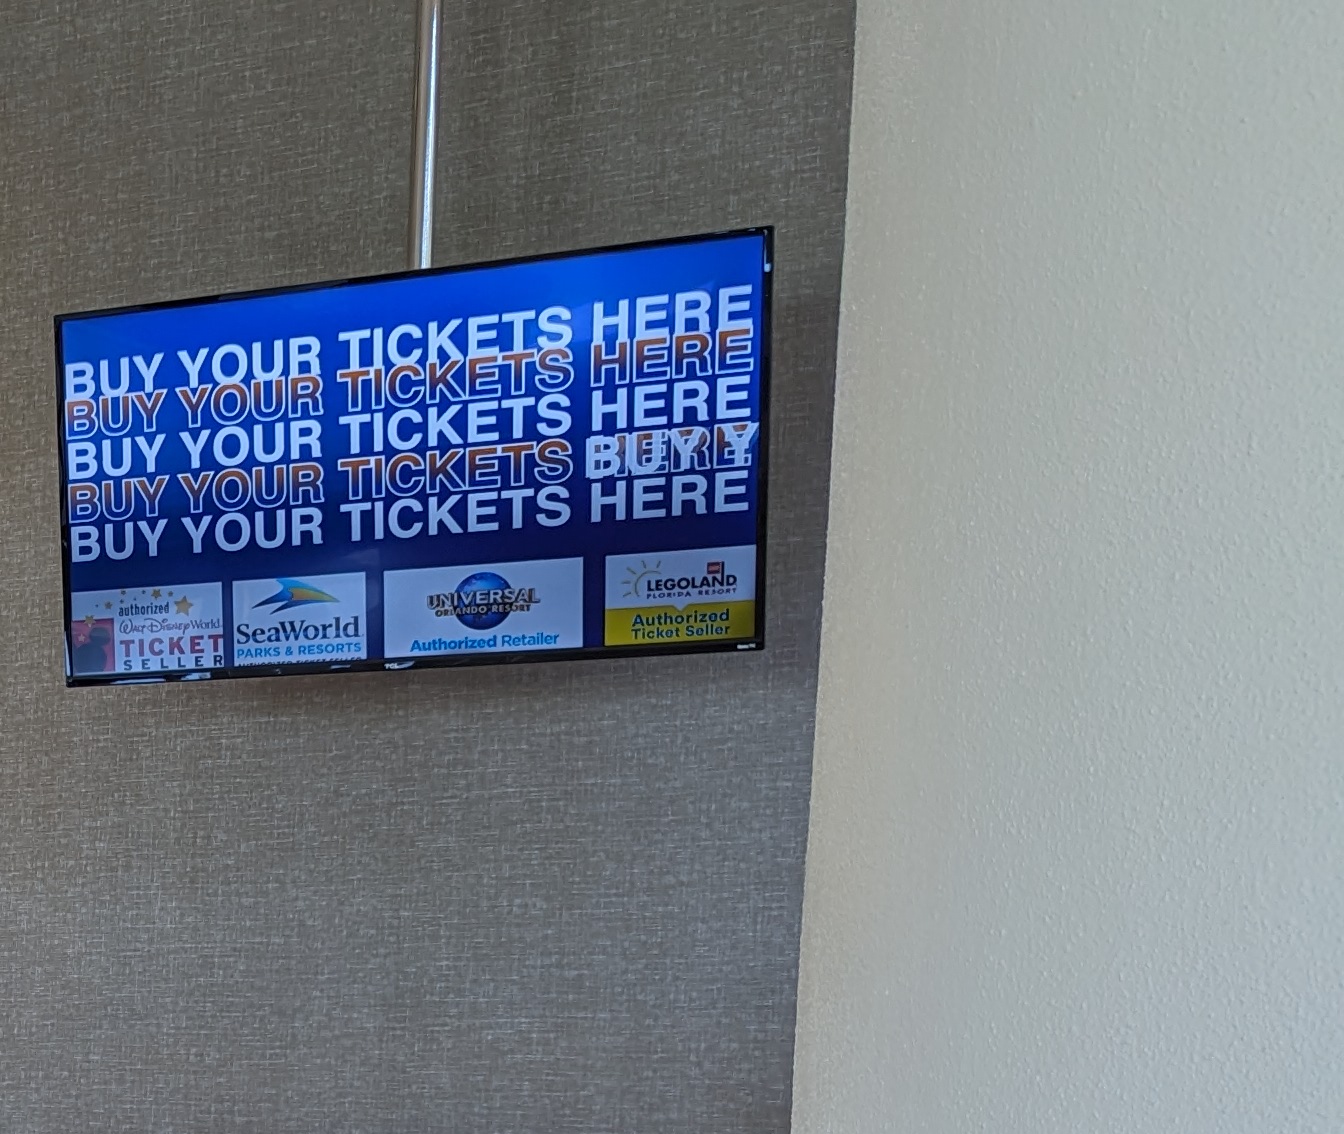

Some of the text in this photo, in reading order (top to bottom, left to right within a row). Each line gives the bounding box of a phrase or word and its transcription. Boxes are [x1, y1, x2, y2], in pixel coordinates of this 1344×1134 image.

[65, 285, 753, 400] BUY YOUR TICKETS HERE
[64, 326, 754, 440] BUY YOUR TICKETS HERE
[67, 375, 752, 480] BUY YOUR TICKETS HERE
[68, 474, 169, 523] BUY
[177, 462, 324, 513] YOUR
[338, 438, 573, 500] TICKETS
[71, 470, 750, 563] BUY YOUR TICKETS HERE
[646, 572, 737, 592] LEGOLAND
[426, 587, 541, 609] UNIVERSAL
[646, 587, 737, 600] FLORIDA RESORT
[118, 602, 170, 617] authorized
[435, 603, 532, 618] ORLANDO RESORT
[632, 608, 730, 628] Authorized
[190, 618, 222, 630] World
[236, 616, 361, 644] SeaWorld
[631, 624, 731, 640] Ticket Seller
[120, 634, 223, 658] TICKET
[237, 642, 362, 659] PARKS & RESORTS
[410, 631, 559, 652] Authorized Retailer
[123, 654, 223, 671] SELLER
